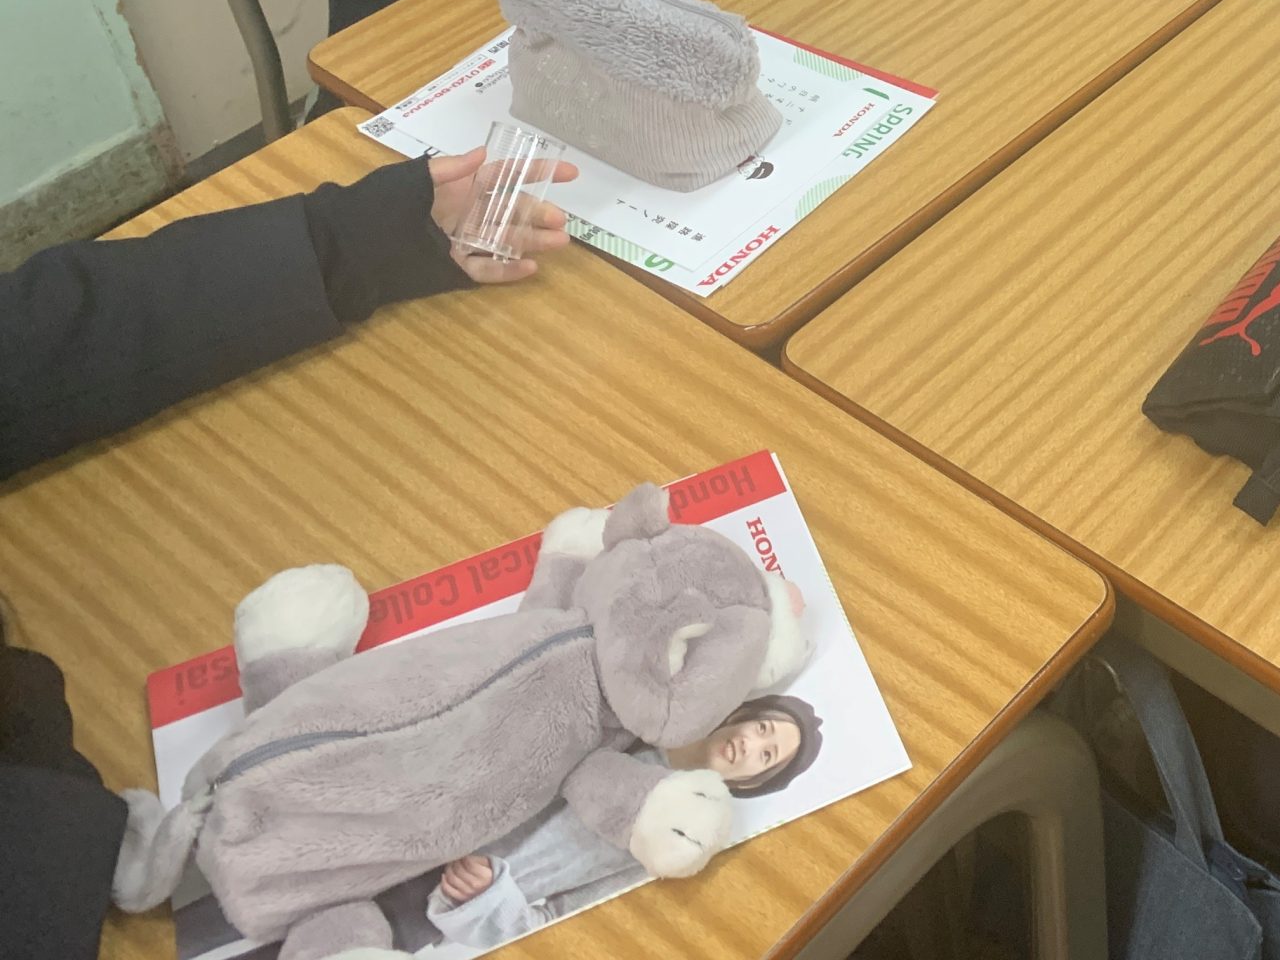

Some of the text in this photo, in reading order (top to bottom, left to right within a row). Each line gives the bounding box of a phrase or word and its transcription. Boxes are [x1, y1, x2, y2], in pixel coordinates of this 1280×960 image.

[832, 102, 876, 138] HONDA
[696, 225, 781, 287] HONDA
[669, 465, 757, 520] Hond
[746, 516, 786, 580] HON
